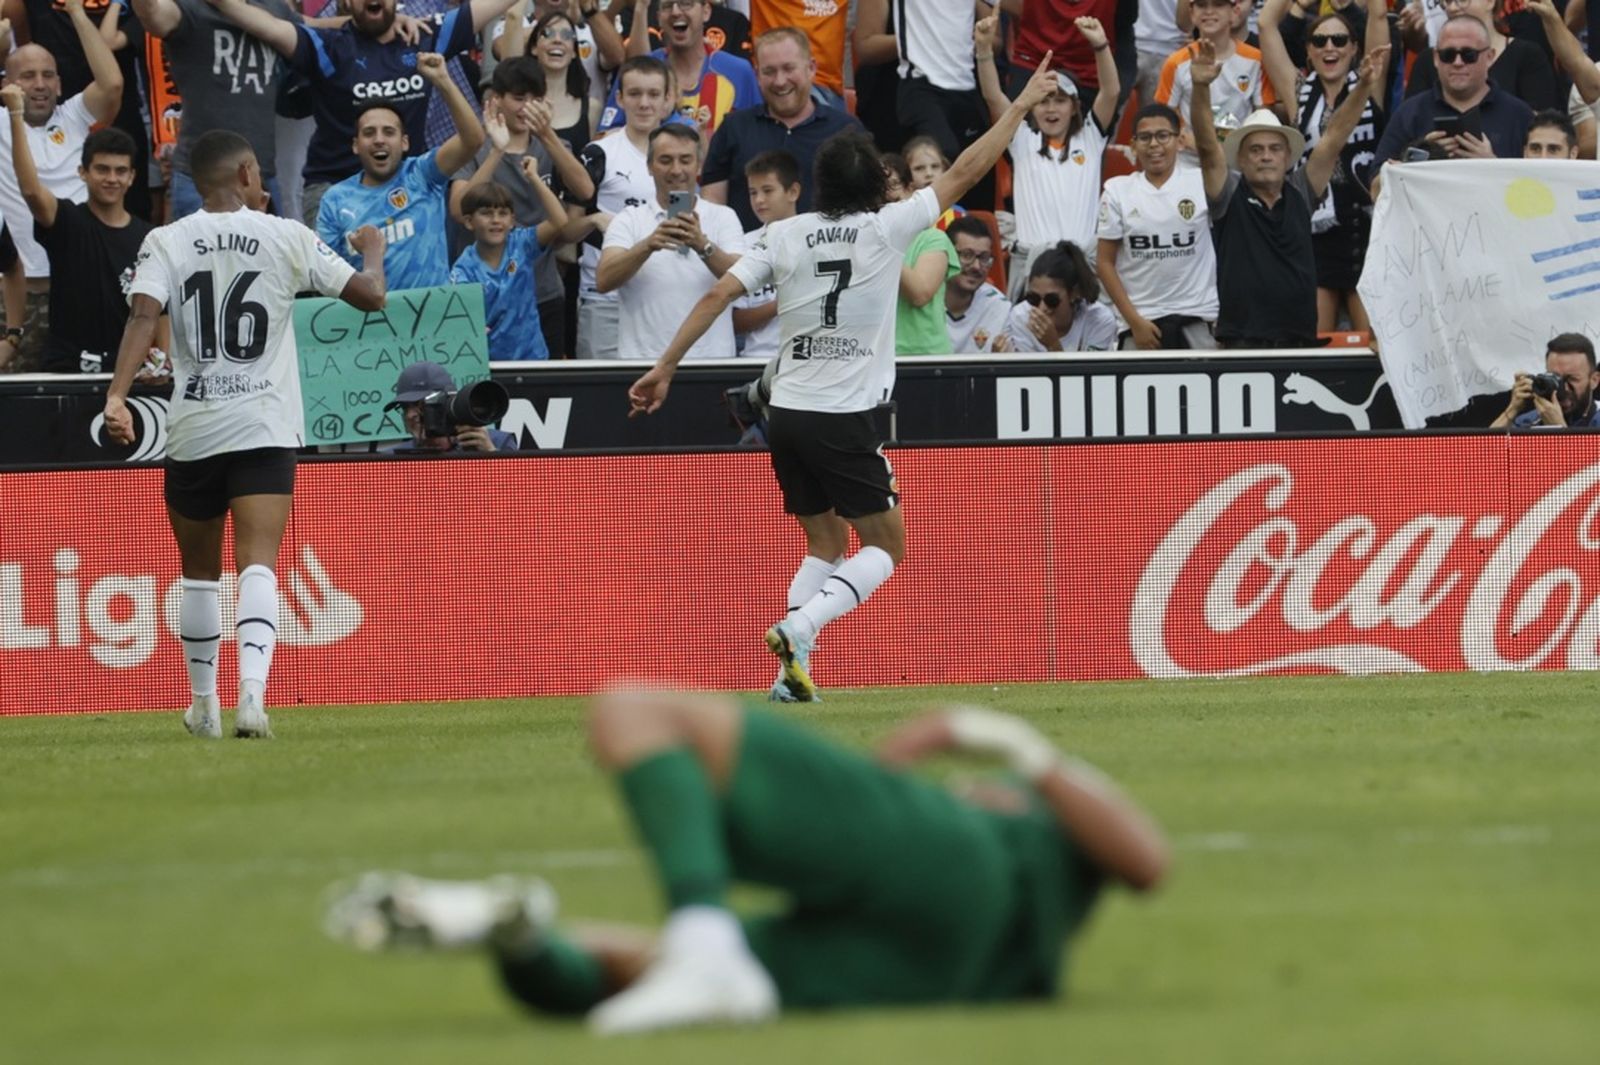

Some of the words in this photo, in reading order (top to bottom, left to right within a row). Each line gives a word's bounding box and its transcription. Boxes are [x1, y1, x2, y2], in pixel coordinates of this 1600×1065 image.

[352, 74, 424, 98] CAZOO
[217, 233, 259, 256] LINO
[806, 227, 859, 248] CAVANI
[1128, 231, 1196, 250] BLÜ
[1130, 247, 1196, 260] smartphones
[814, 258, 853, 329] 7
[180, 270, 269, 363] 16
[812, 346, 874, 358] BRIGANTINA
[813, 337, 859, 348] HERRERO
[304, 354, 342, 379] LA
[202, 374, 251, 387] HERRERO
[343, 389, 383, 411] 1000
[996, 371, 1276, 440] PUMA
